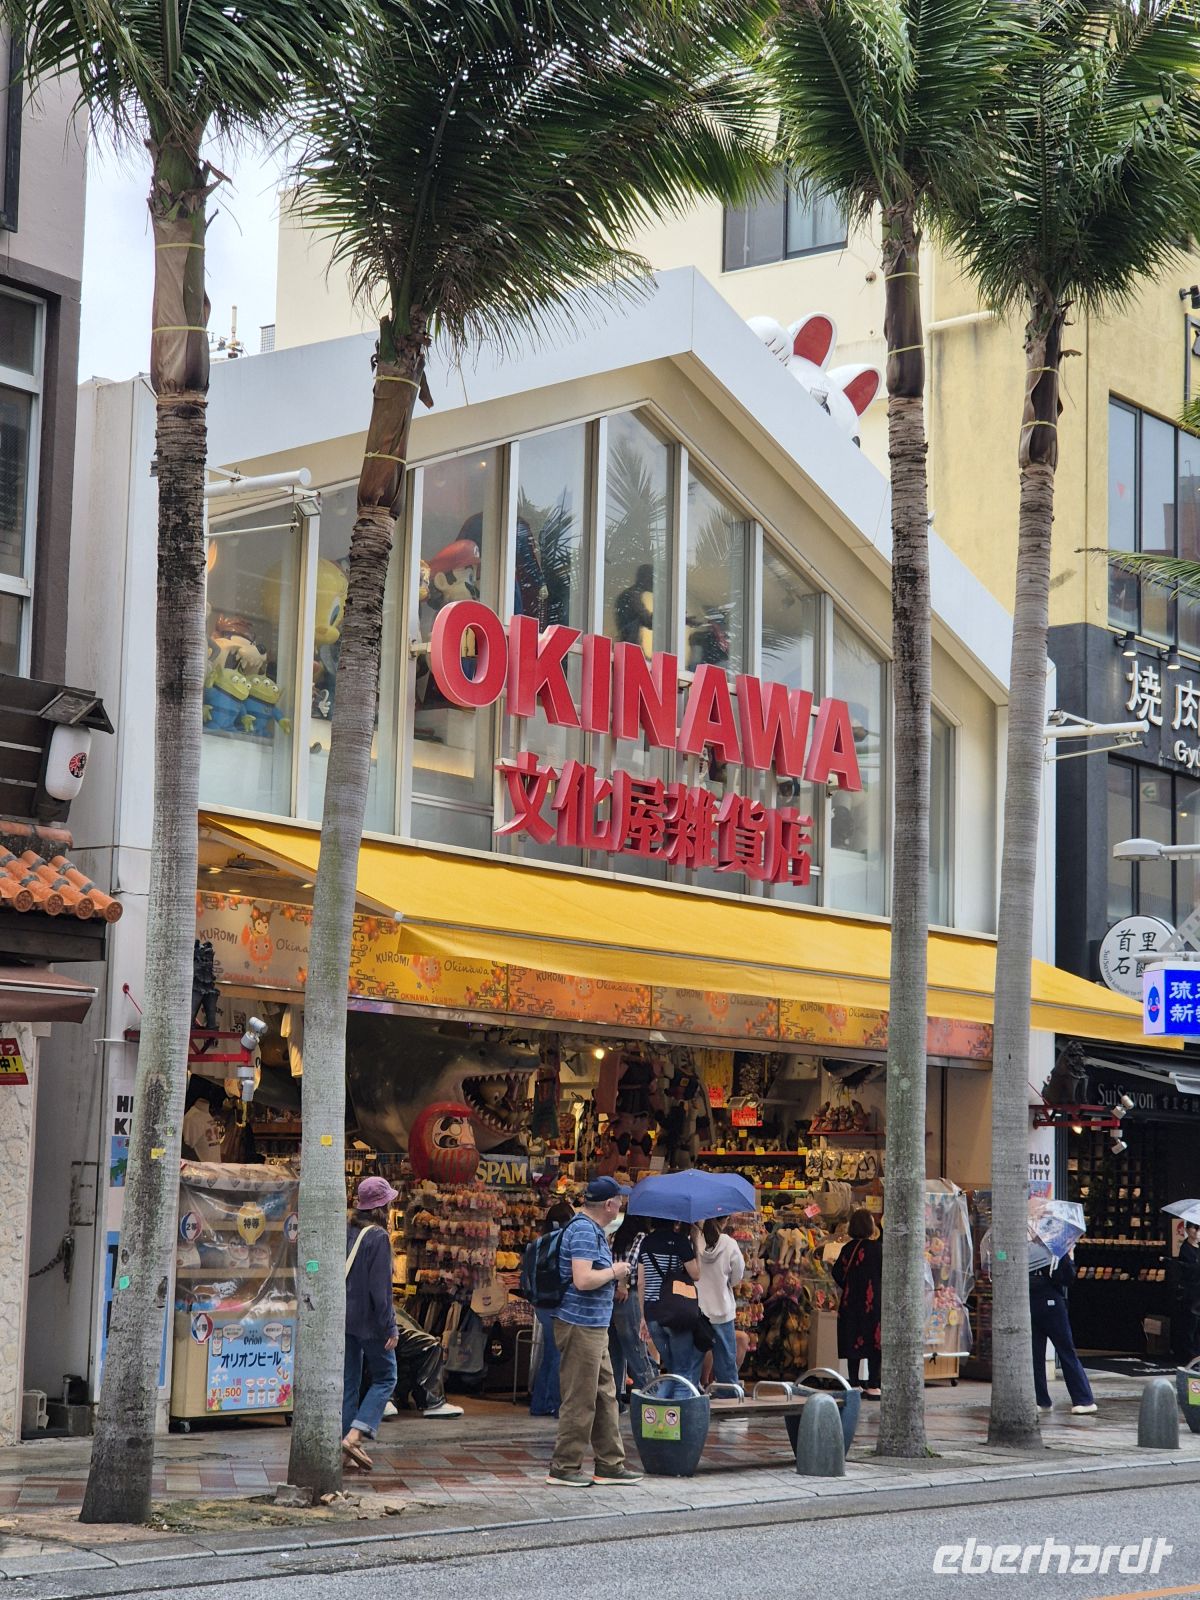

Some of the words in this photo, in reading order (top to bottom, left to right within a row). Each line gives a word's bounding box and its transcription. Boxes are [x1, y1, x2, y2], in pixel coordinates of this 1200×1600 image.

[431, 600, 863, 792] OKINAWA
[199, 928, 238, 945] KUROMI
[1116, 928, 1157, 953] 首里
[376, 951, 410, 967] KUROMI
[444, 959, 490, 976] Okinawa
[536, 971, 566, 985] KUROMI
[475, 1160, 527, 1185] SPAM
[220, 1351, 282, 1369] オリオンビール
[211, 1387, 242, 1399] ¥1,500
